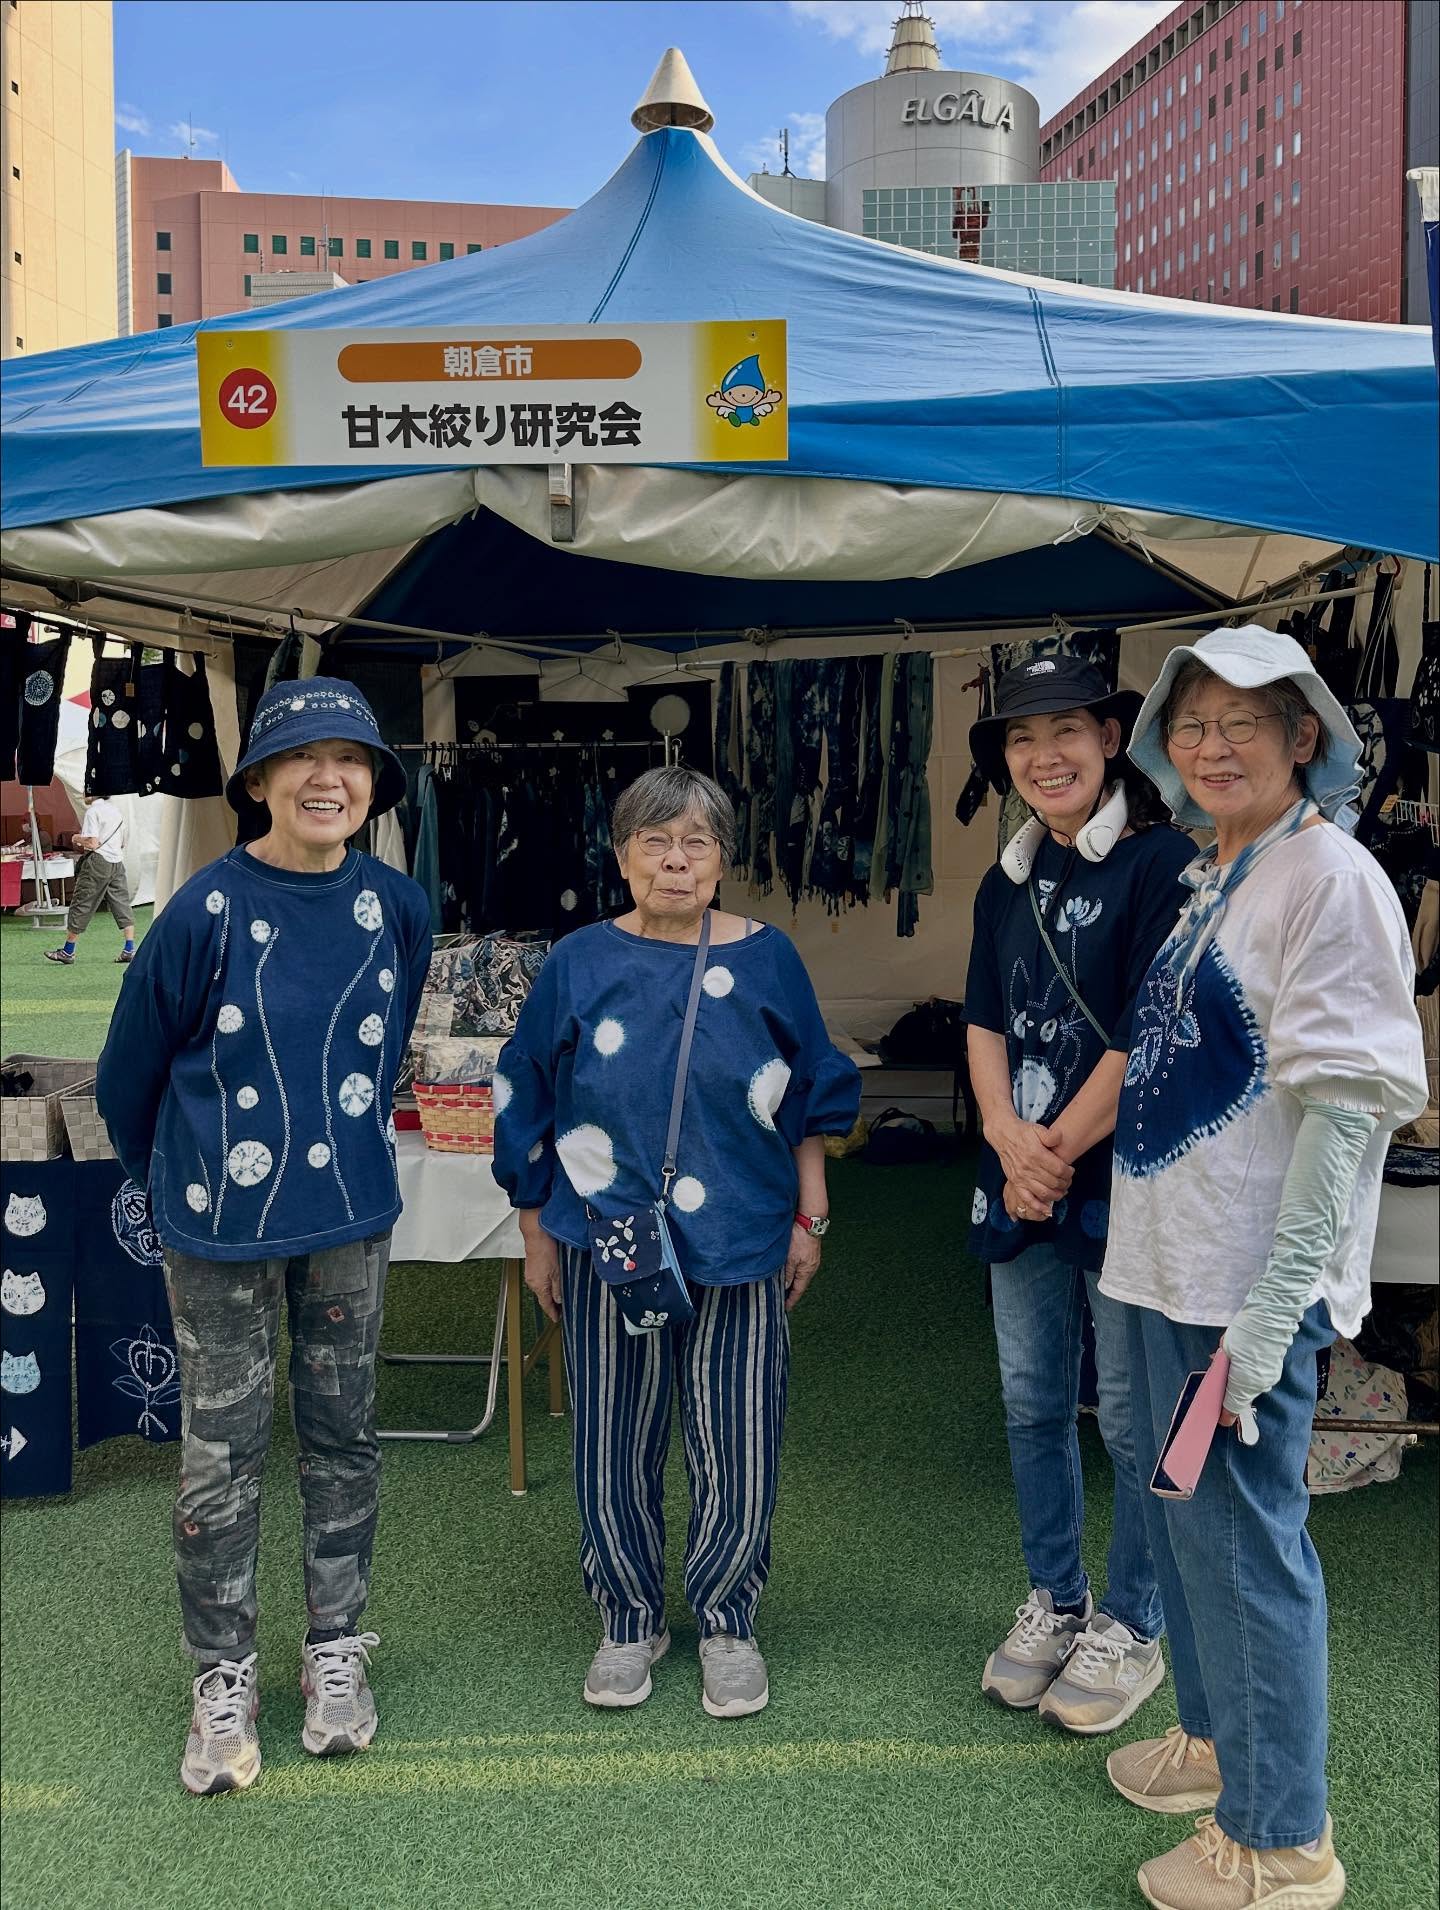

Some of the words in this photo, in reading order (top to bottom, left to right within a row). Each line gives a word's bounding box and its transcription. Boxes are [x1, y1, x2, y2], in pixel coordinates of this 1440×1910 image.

[443, 345, 534, 377] 朝倉市
[227, 385, 269, 414] 42
[341, 401, 643, 449] 甘木絞り研究会
